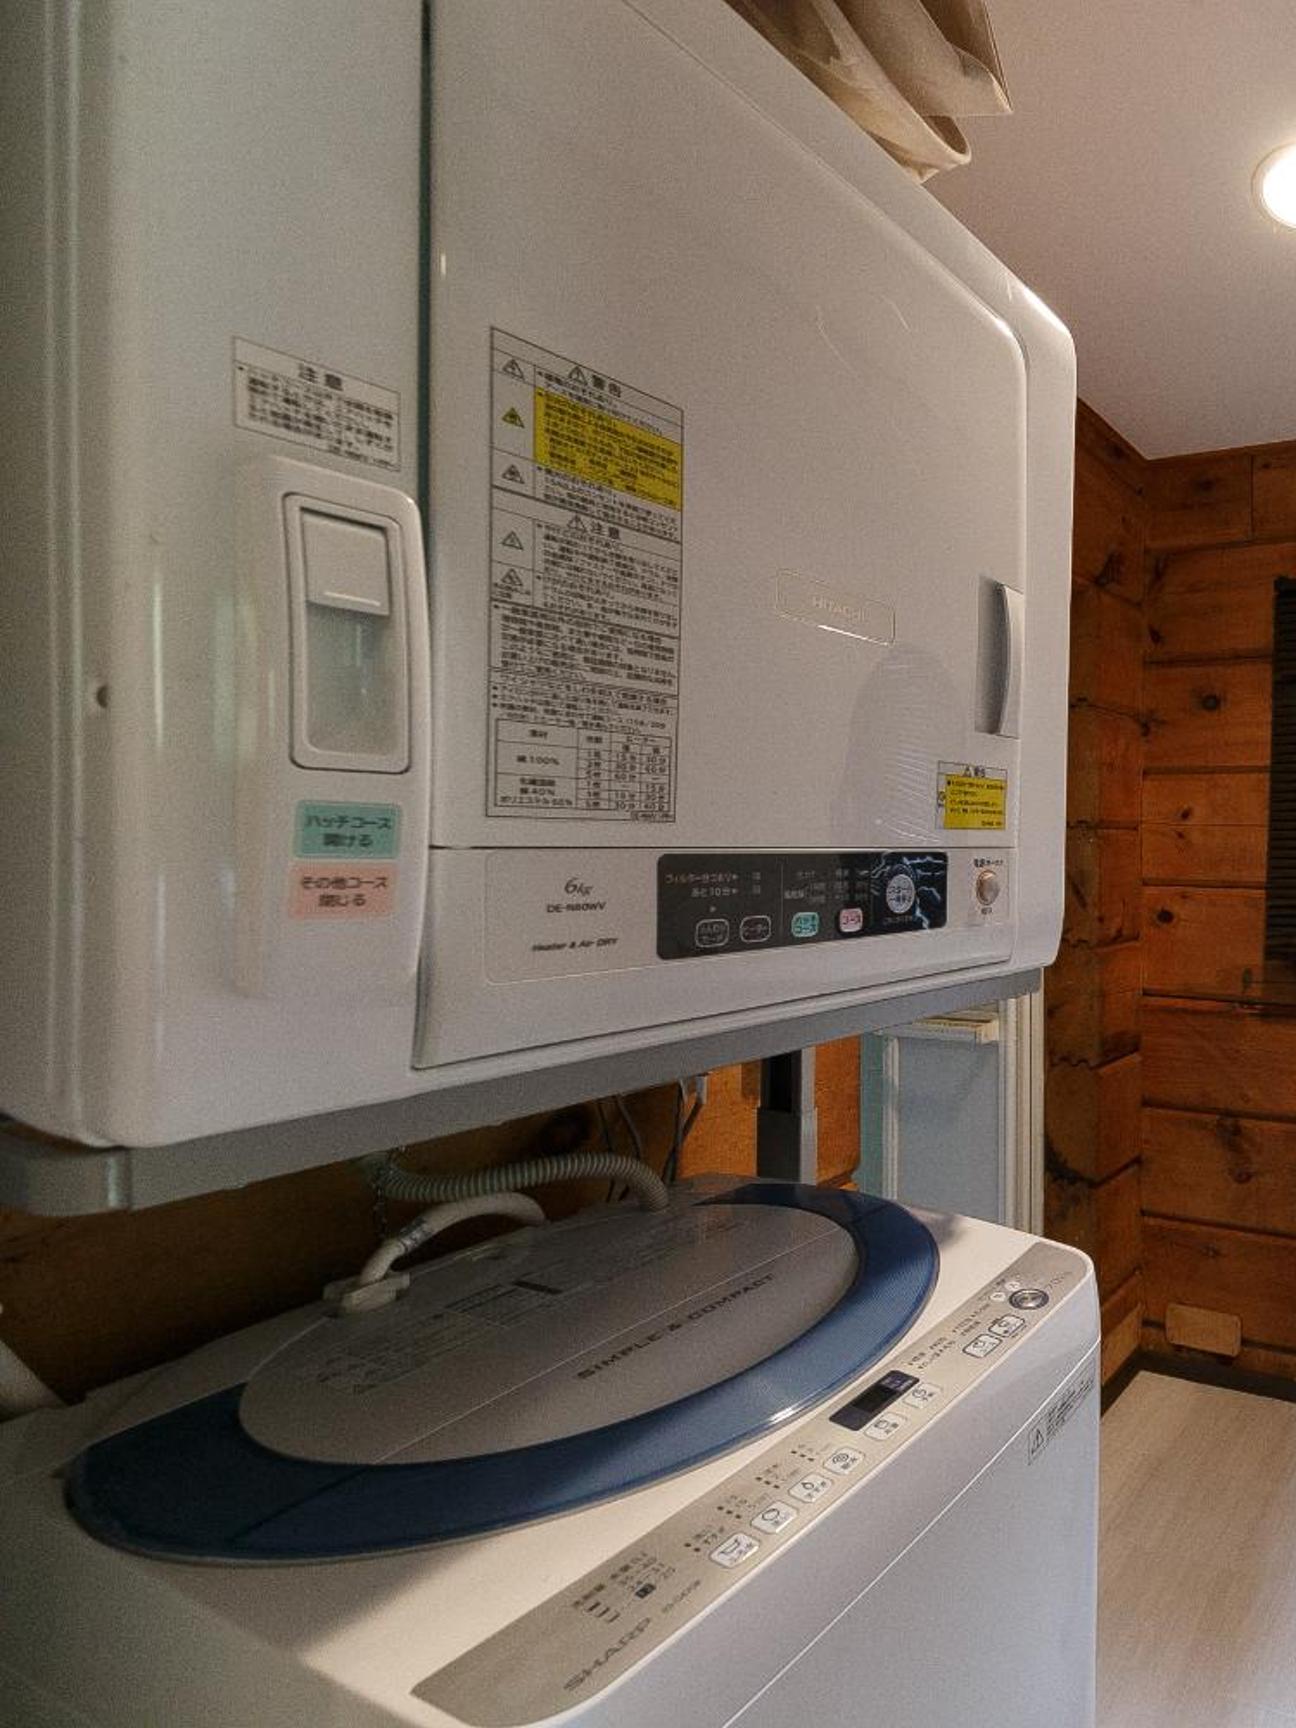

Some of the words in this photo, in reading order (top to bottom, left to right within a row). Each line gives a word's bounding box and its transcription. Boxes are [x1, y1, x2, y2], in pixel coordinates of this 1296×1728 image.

[577, 1332, 662, 1380] SIMPLE
[687, 1273, 775, 1320] COMPACT
[563, 1617, 651, 1690] SHARP
